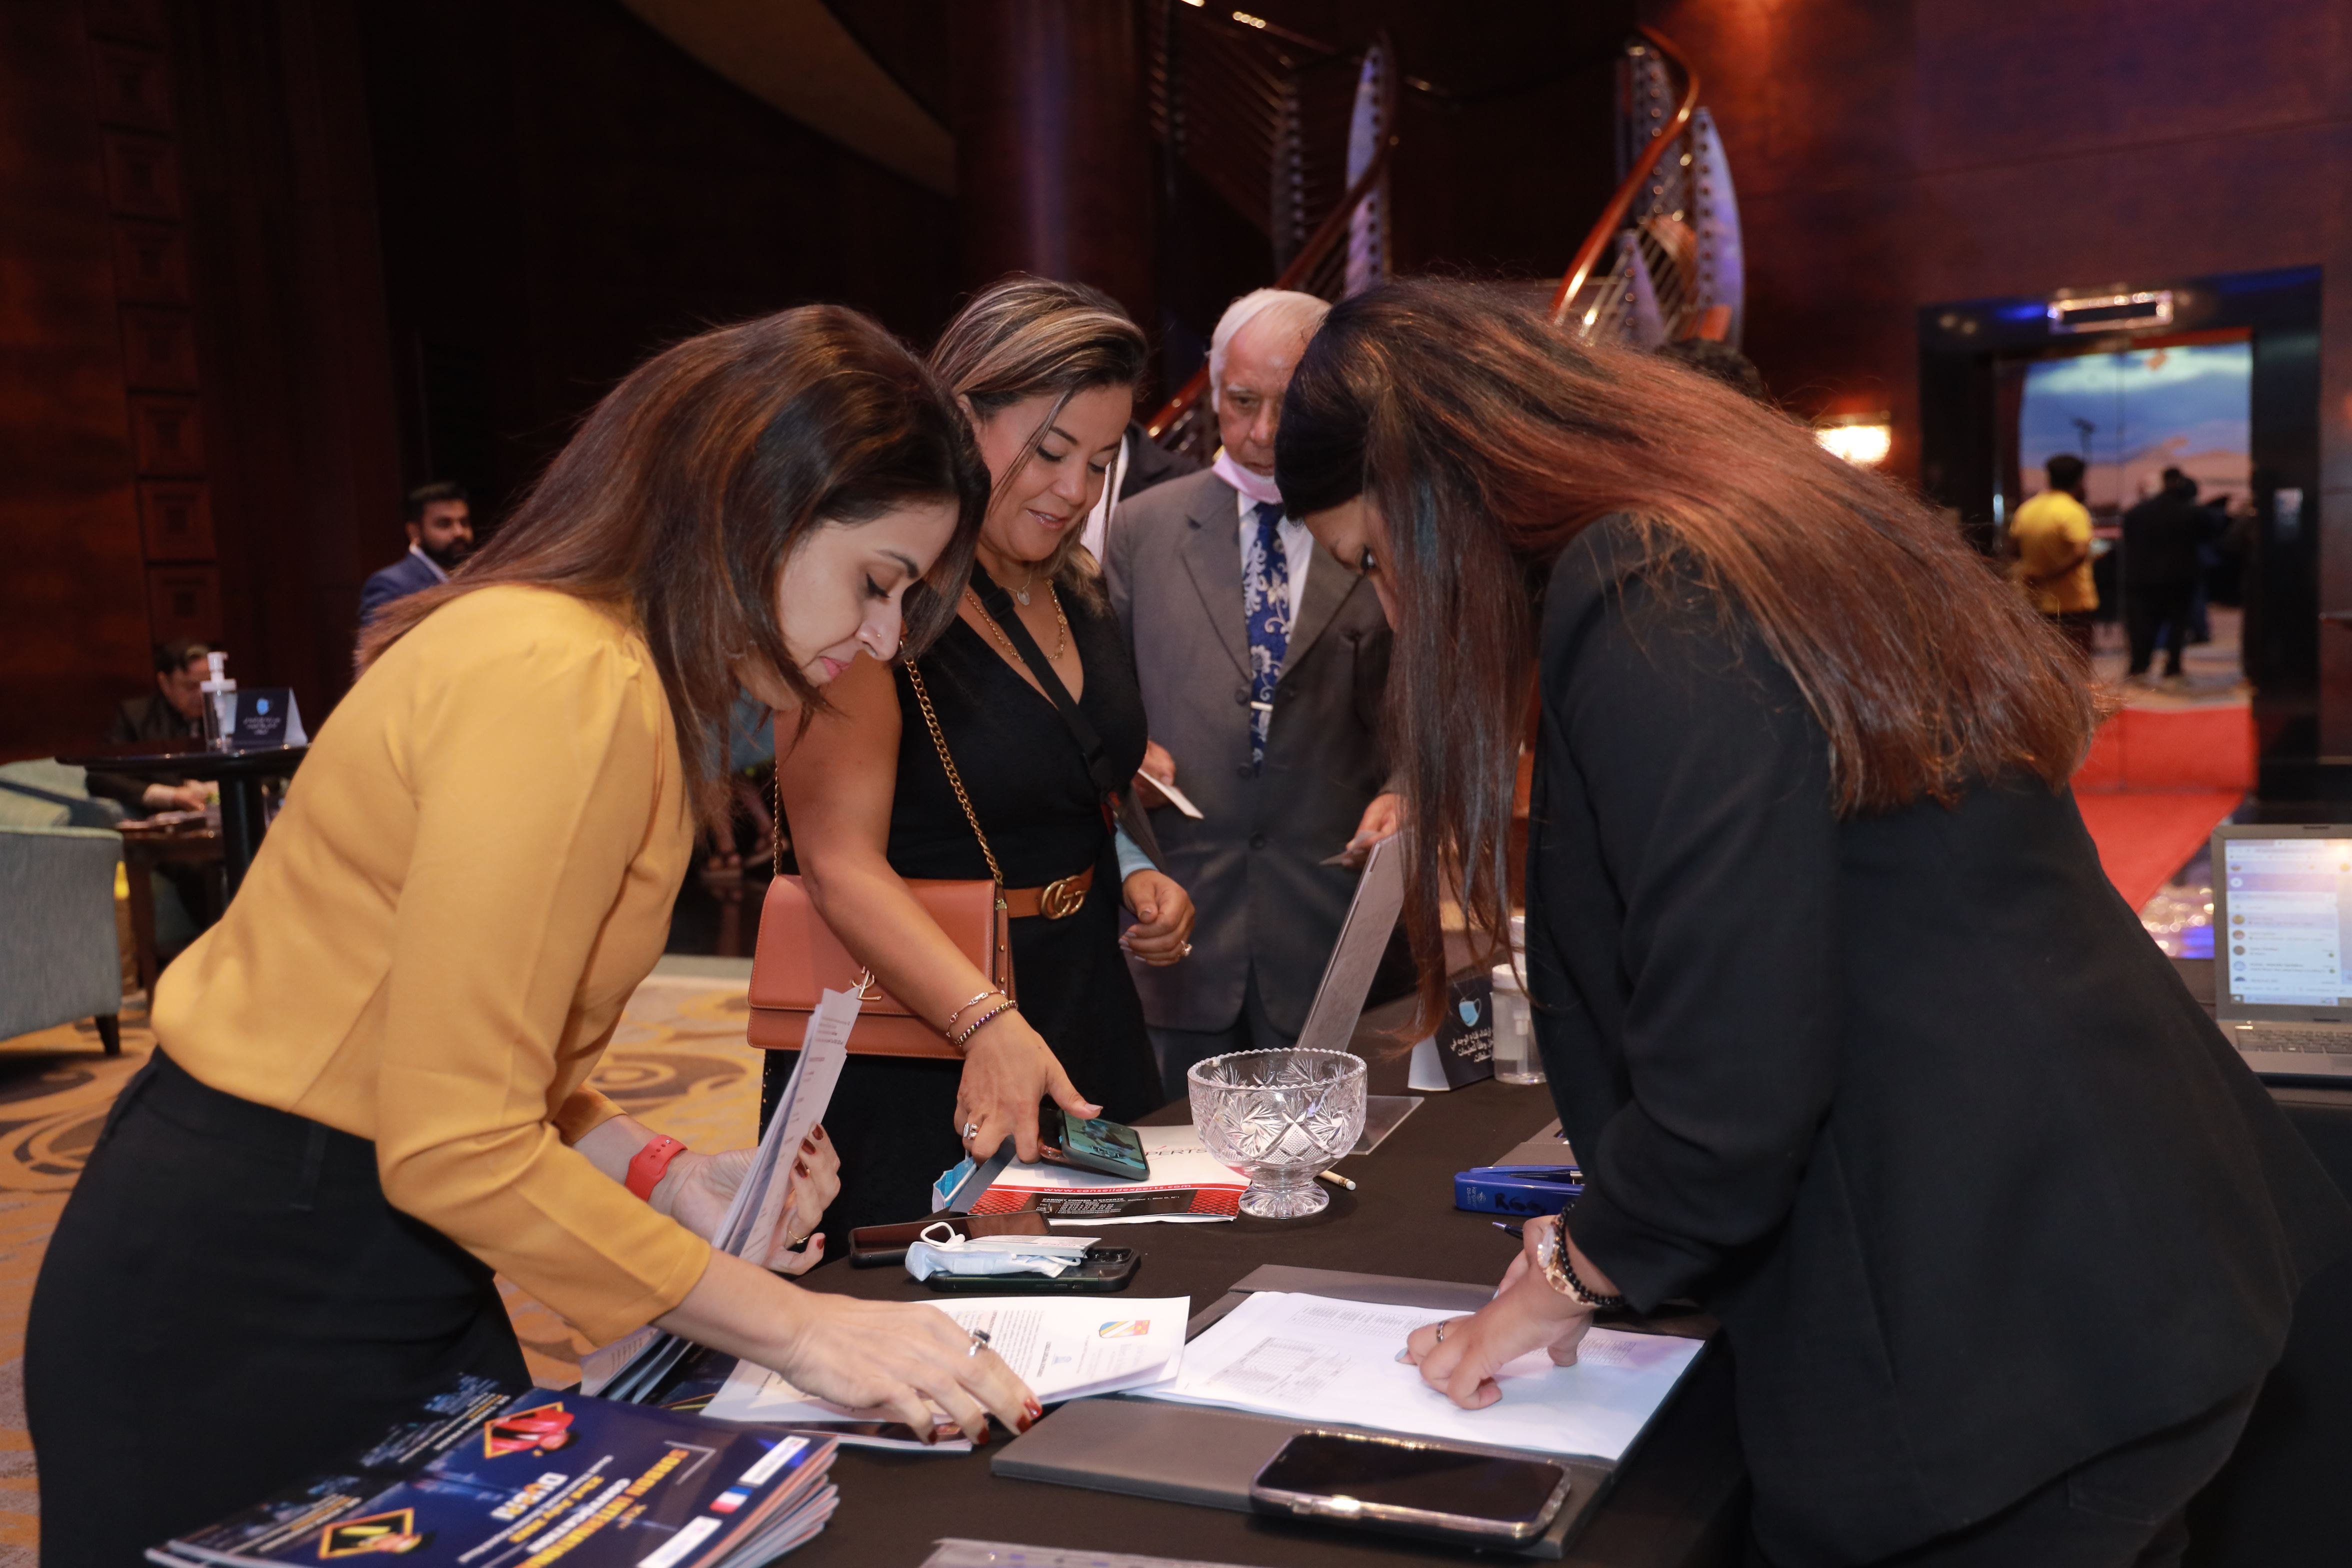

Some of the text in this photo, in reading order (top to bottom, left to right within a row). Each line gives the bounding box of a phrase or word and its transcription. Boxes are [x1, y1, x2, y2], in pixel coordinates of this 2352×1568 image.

[1044, 1184, 1191, 1192] www.conseildexperts.com
[624, 1448, 690, 1497] SORBON
[526, 1478, 632, 1554] CONVOCATION
